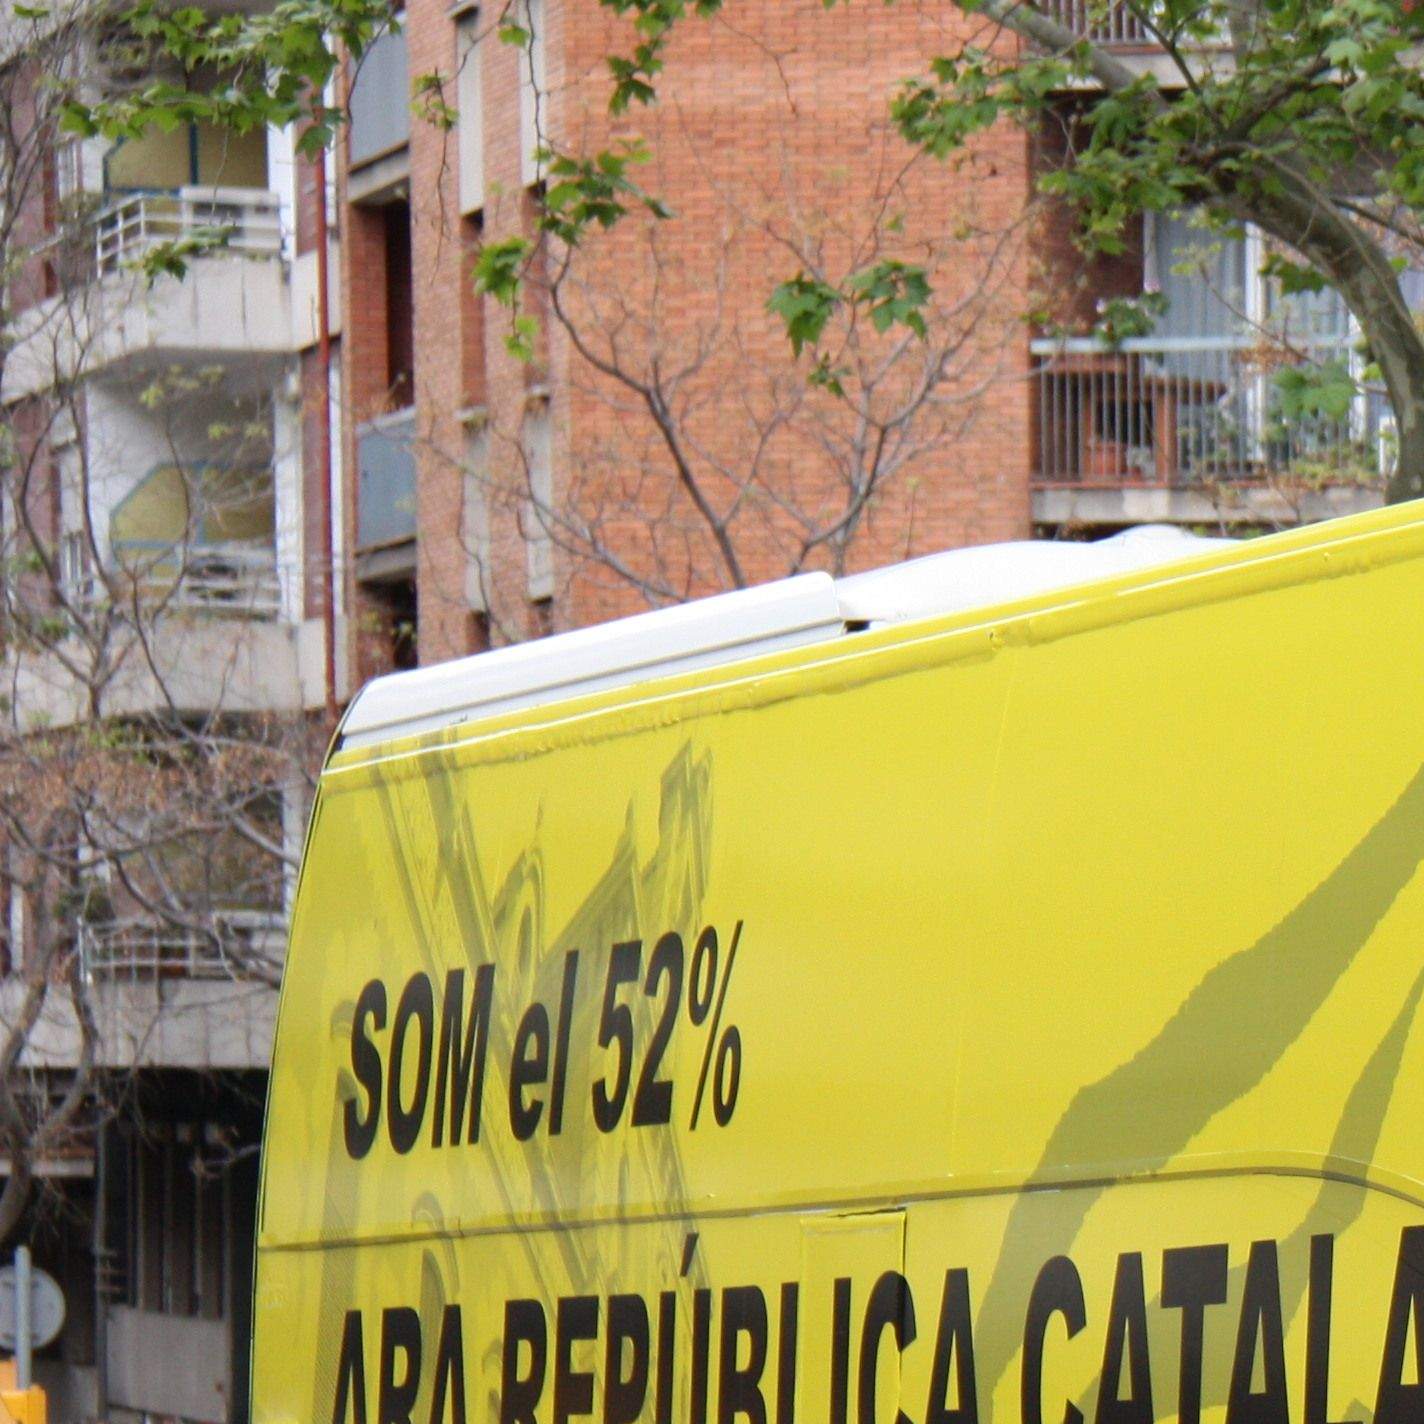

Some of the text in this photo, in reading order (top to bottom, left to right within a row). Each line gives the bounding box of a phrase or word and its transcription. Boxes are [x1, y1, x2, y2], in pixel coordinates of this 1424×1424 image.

[342, 919, 744, 1160] SOM el 52%
